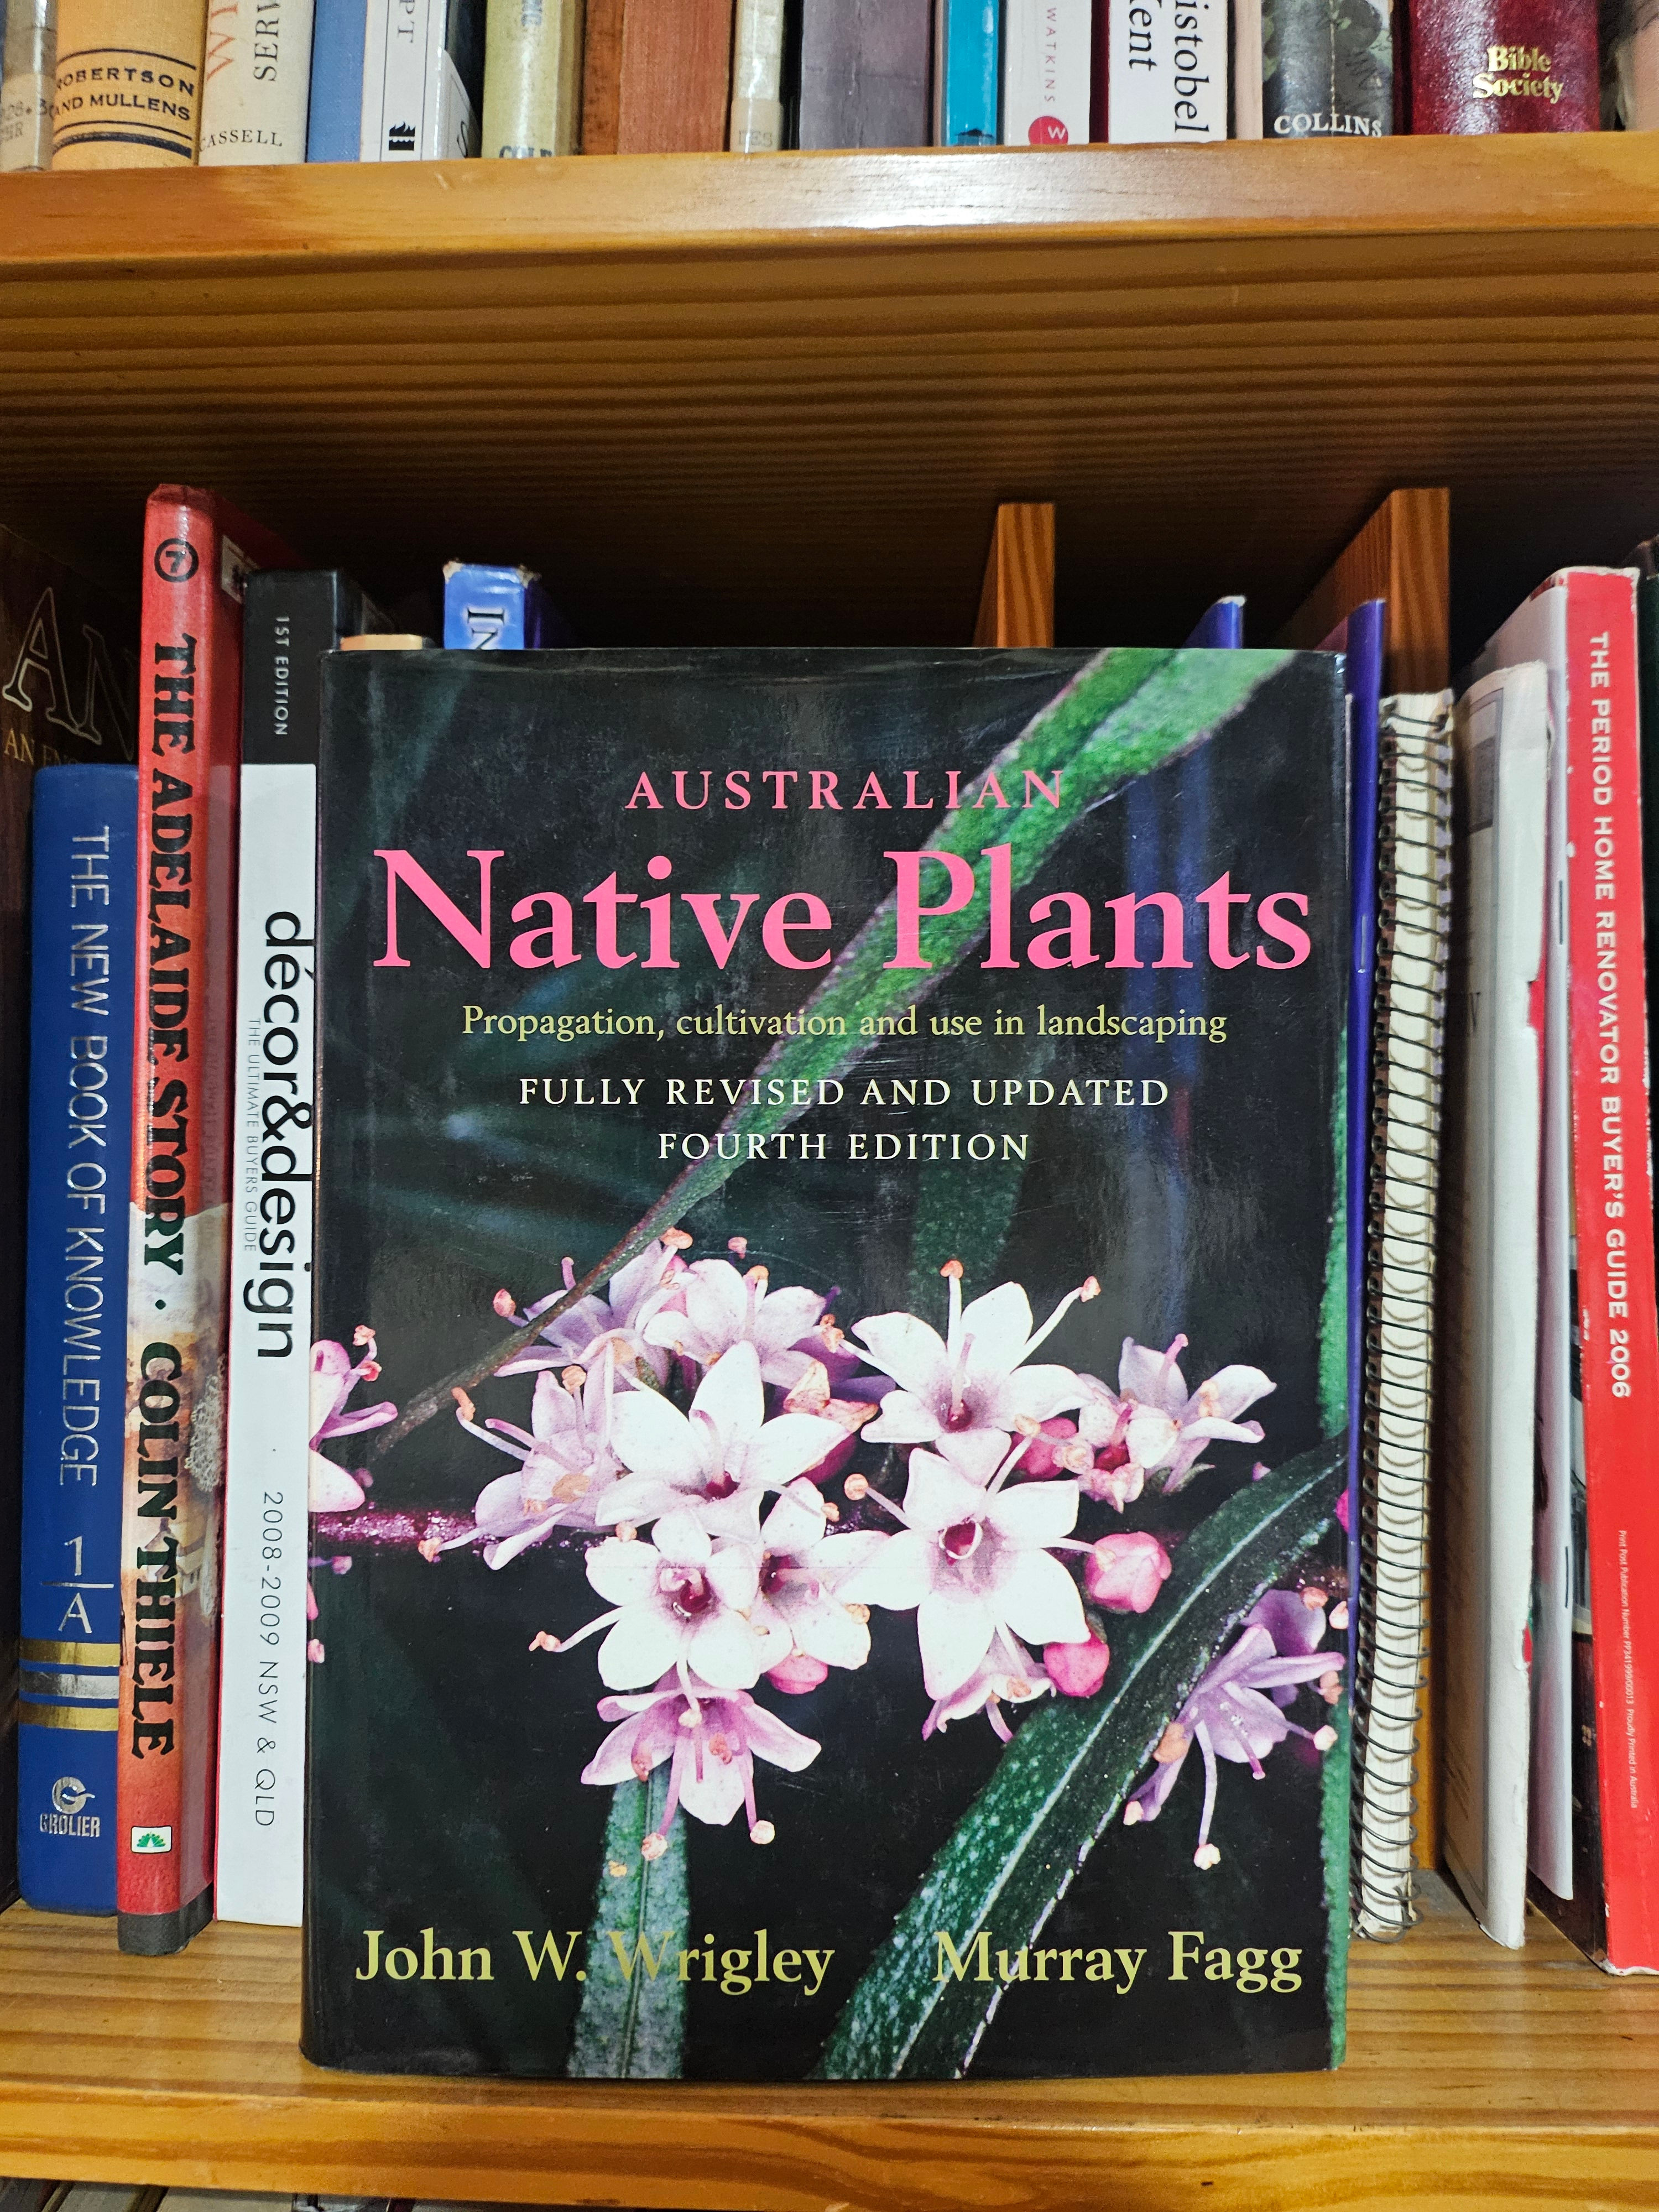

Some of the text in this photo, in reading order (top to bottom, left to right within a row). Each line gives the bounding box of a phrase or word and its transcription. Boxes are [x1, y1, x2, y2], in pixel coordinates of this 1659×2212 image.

[1045, 7, 1057, 103] WATKINS
[1129, 0, 1162, 71] ent
[1174, 0, 1209, 132] istobel
[1486, 45, 1552, 72] Bible
[90, 93, 191, 121] MULLENS
[1472, 71, 1564, 104] Society
[199, 129, 283, 152] CASSELL
[1274, 113, 1382, 138] COLLINS
[273, 617, 290, 735] 1ST EDITION
[625, 771, 1063, 810] AUSTRALIAN
[373, 843, 1311, 970] Native Plants
[144, 633, 197, 1276] THE ADELAIDE STORY
[462, 1004, 1228, 1044] Propagation, cultivation and use in landscaping
[1589, 632, 1631, 1398] THE PERIOD HOME RENOVATOR BUYER'S GUIDE 2006
[519, 1078, 1168, 1106] FULLY REVISED AND UPDATED
[244, 1018, 261, 1251] THE ULTIMATE BUYERS GUIDE
[658, 1133, 1029, 1160] FOURTH EDITION
[59, 825, 109, 1486] THE NEW BOOK OF KNOWLEDGE
[64, 1536, 83, 1576] 1
[131, 1342, 182, 1760] COLIN THIELE
[1618, 1530, 1627, 1547] Print
[1619, 1549, 1628, 1566] Post
[1620, 1567, 1630, 1607] Publication
[58, 1592, 92, 1634] A
[1622, 1609, 1631, 1639] Number
[255, 1491, 283, 1826] 2008-2009 NSW & QLD
[1625, 1709, 1635, 1736] Proudly
[1627, 1738, 1637, 1765] Printed
[1629, 1776, 1639, 1809] Australia
[40, 1814, 100, 1838] GROLIER
[355, 1927, 1302, 1996] John W. Wrigley Murray Fagg
